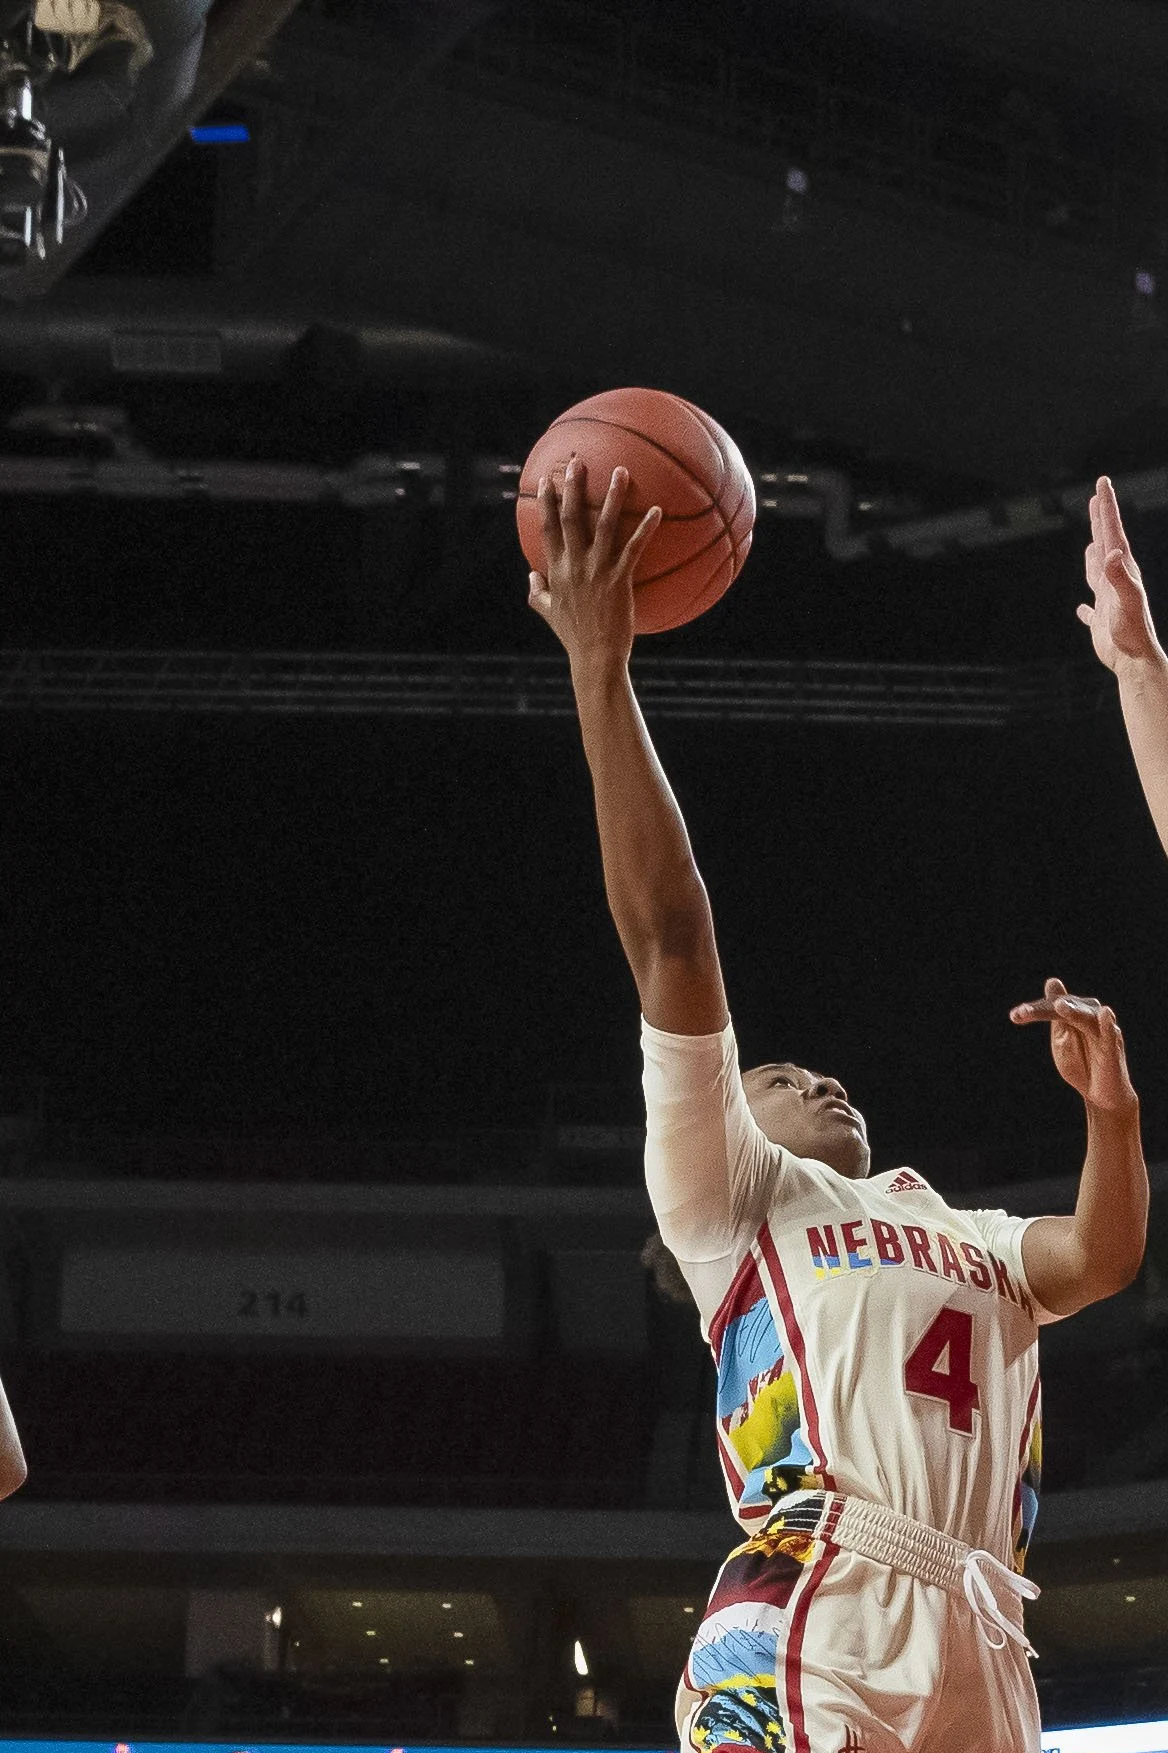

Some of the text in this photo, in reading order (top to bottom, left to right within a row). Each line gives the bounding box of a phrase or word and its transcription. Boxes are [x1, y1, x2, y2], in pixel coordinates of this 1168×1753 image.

[885, 1182, 927, 1195] adidas
[237, 1289, 309, 1318] 214
[905, 1307, 981, 1437] 4
